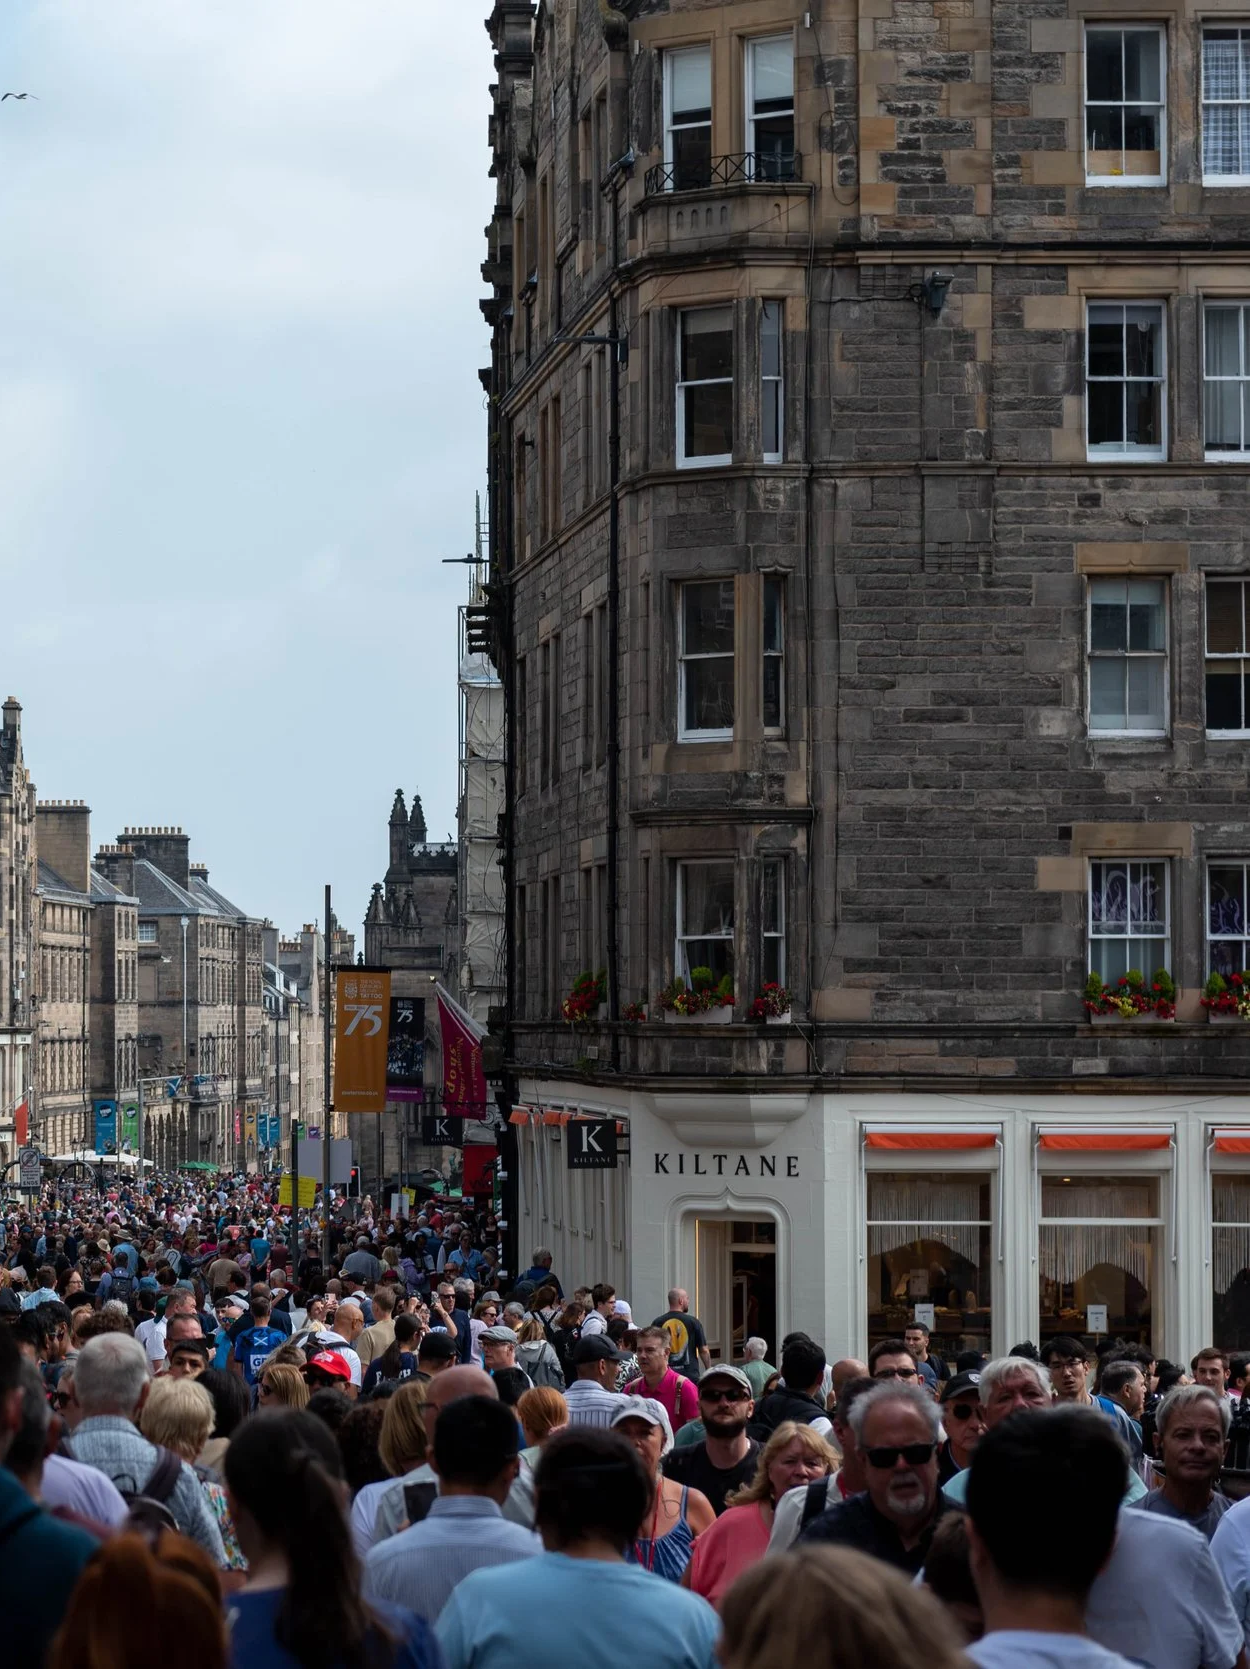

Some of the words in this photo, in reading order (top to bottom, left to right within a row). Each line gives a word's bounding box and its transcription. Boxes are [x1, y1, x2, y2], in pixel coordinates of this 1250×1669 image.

[344, 1005, 382, 1036] 75
[397, 1010, 413, 1022] 75
[436, 1120, 449, 1136] K
[581, 1126, 602, 1152] K
[654, 1153, 800, 1177] KILTANE
